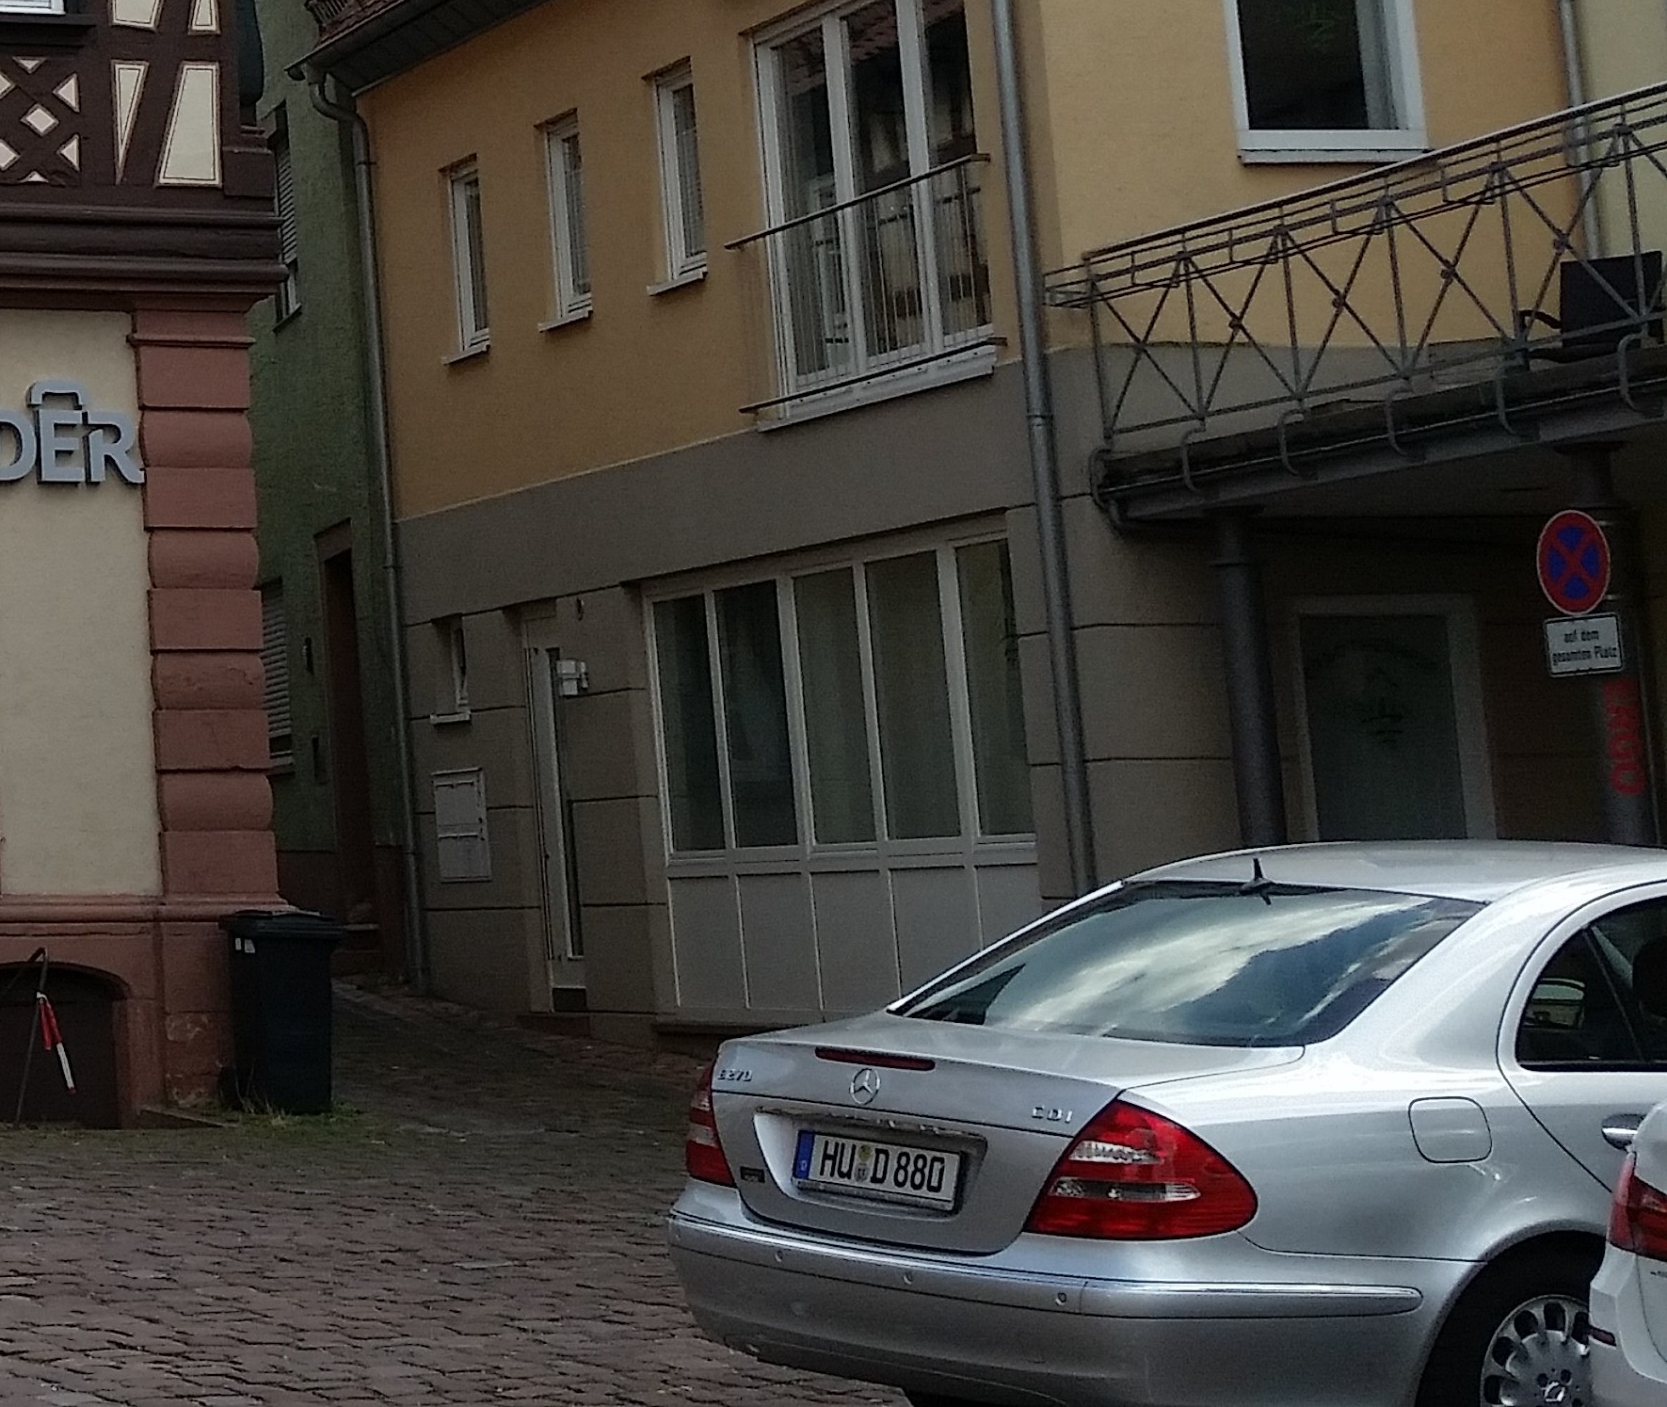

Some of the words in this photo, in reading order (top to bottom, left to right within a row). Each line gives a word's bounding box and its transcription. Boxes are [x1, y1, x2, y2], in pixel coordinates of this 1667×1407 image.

[1581, 630, 1599, 642] dem
[1594, 645, 1618, 661] Platz
[1604, 679, 1647, 796] ERGO
[1031, 1105, 1073, 1124] CDI
[820, 1140, 856, 1180] HU
[870, 1147, 890, 1184] D
[893, 1151, 945, 1193] 880
